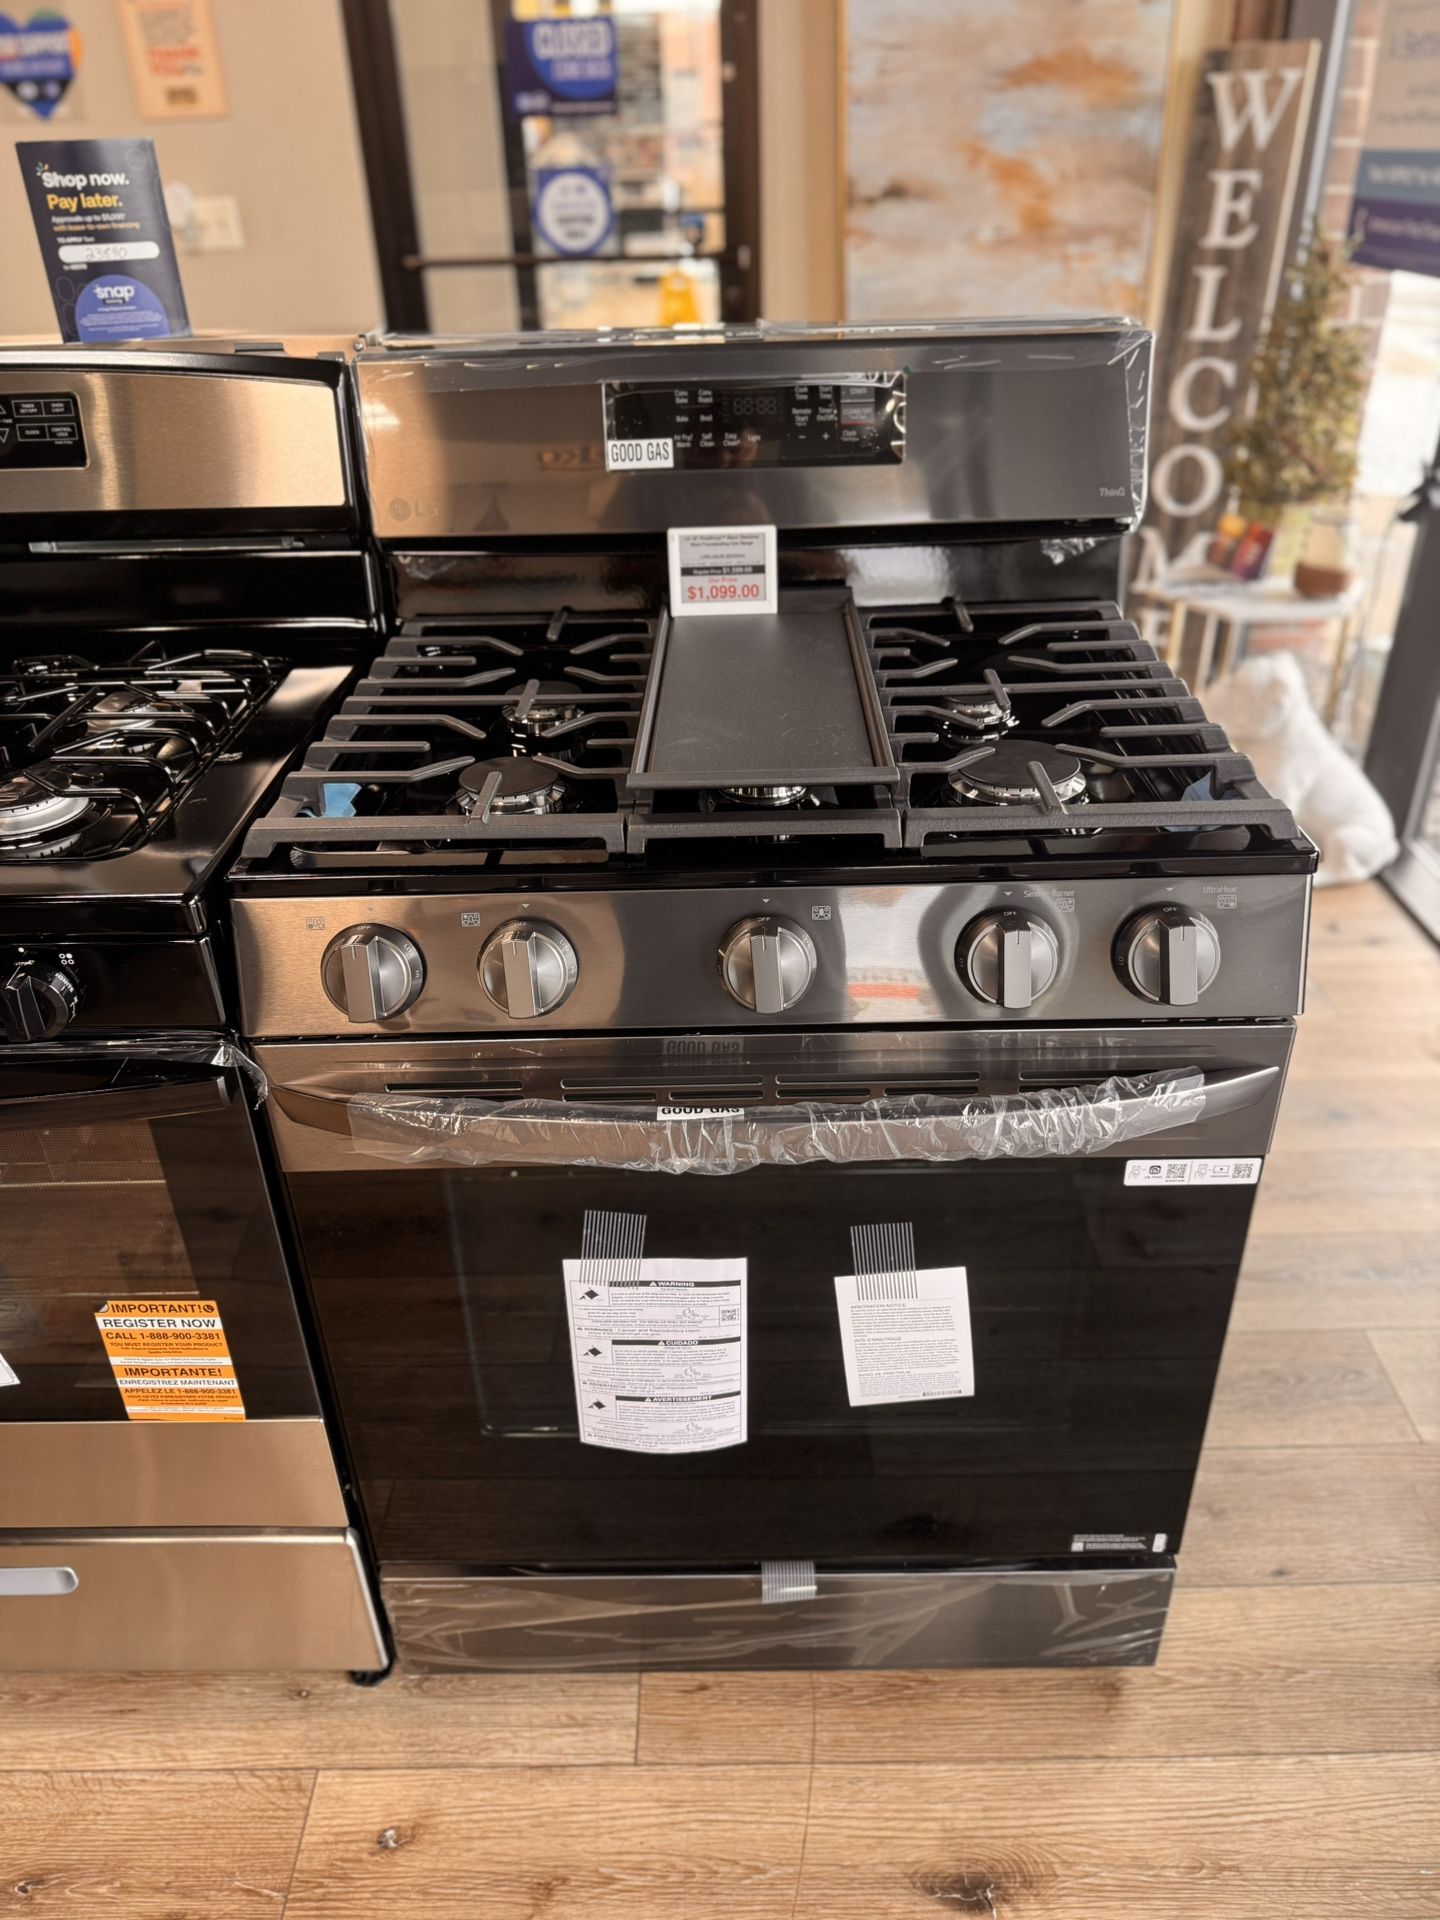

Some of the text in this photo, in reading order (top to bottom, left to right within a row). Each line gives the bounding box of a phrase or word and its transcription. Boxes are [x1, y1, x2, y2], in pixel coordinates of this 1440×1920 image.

[41, 171, 131, 191] Shop now.
[46, 192, 124, 213] Pay later.
[94, 284, 136, 302] snap
[611, 441, 670, 462] GOOD GAS
[1098, 487, 1126, 497] ThinQ
[687, 583, 760, 600] $1,099.00
[111, 1303, 202, 1314] IMPORTANT!
[103, 1318, 216, 1328] REGISTER NOW
[105, 1332, 220, 1340] CALL 1-888-900-3381
[124, 1367, 222, 1377] IMPORTANTE!
[652, 1394, 713, 1402] AVERTISSEMENT
